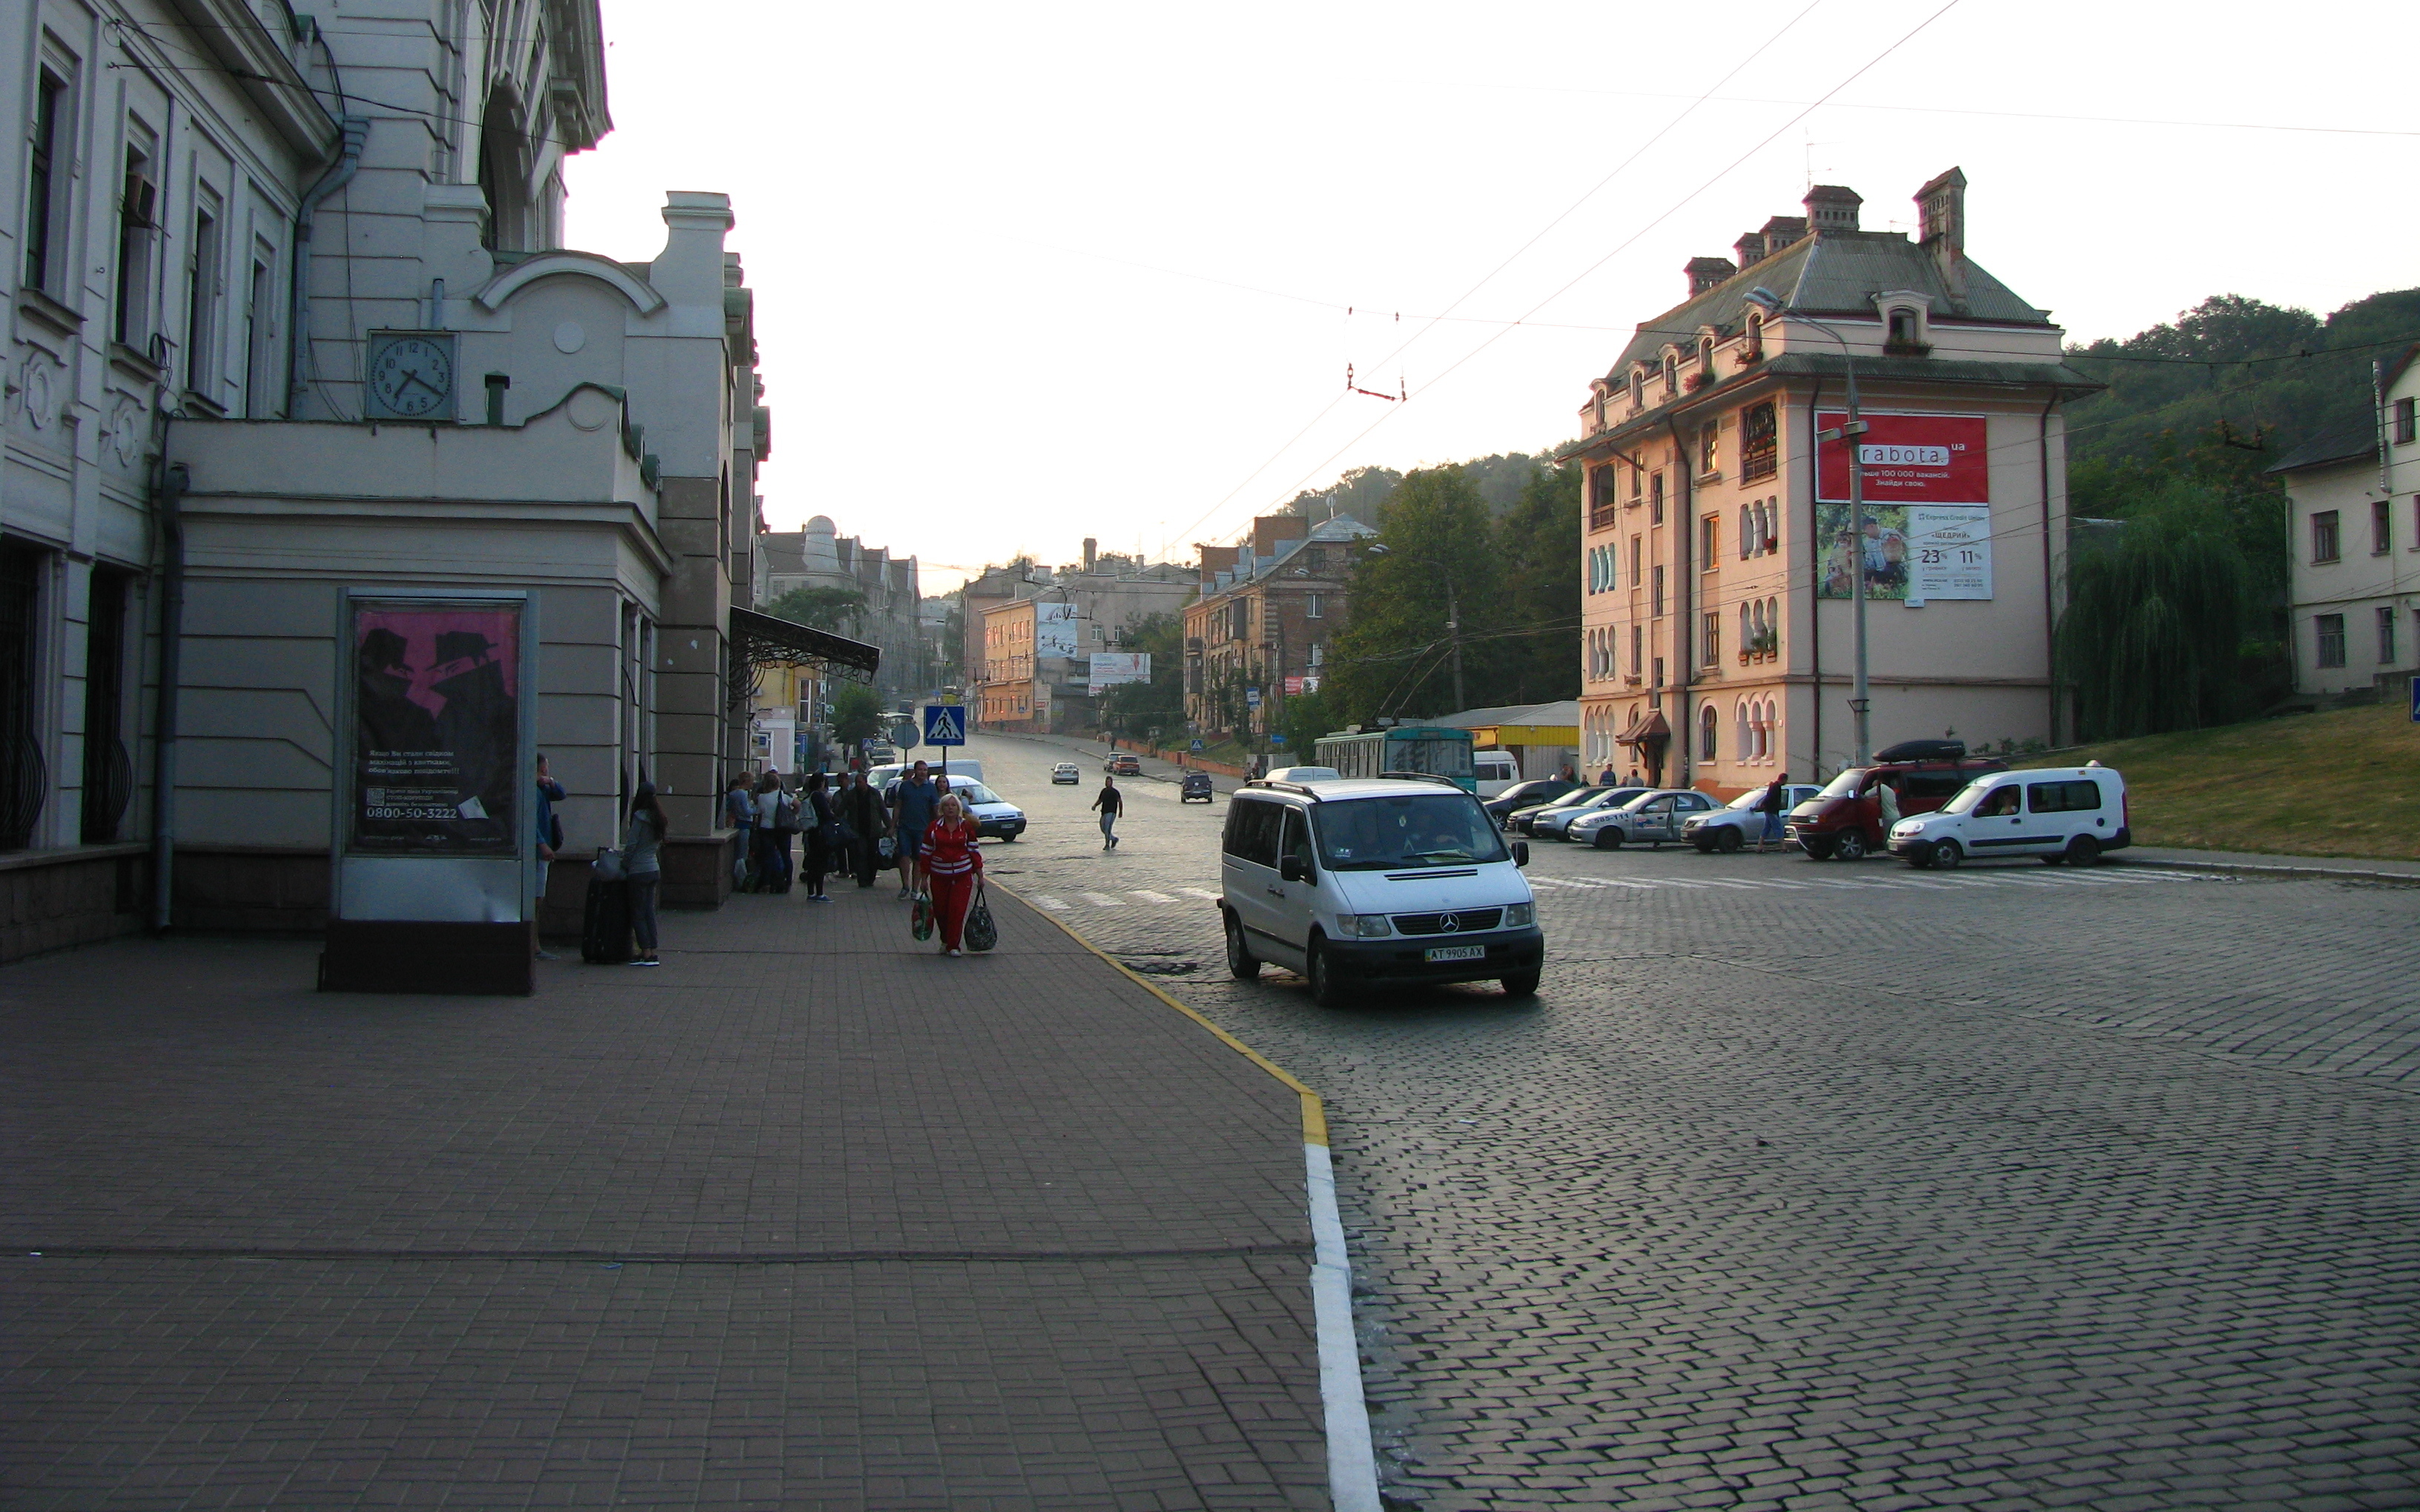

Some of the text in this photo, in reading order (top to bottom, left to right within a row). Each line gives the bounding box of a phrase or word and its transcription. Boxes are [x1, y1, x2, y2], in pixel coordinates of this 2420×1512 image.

[396, 346, 403, 357] 11
[409, 342, 419, 354] 12
[386, 358, 396, 369] 10
[432, 359, 439, 370] 2
[379, 371, 386, 381] 9
[438, 372, 445, 383] 3
[386, 383, 391, 394] 8
[407, 401, 414, 411] 6
[420, 397, 427, 408] 5
[1951, 442, 1966, 451] ua
[1897, 470, 1914, 478] 000
[367, 807, 457, 819] 0800-50-3222
[1432, 947, 1482, 960] AT 9905 AX
